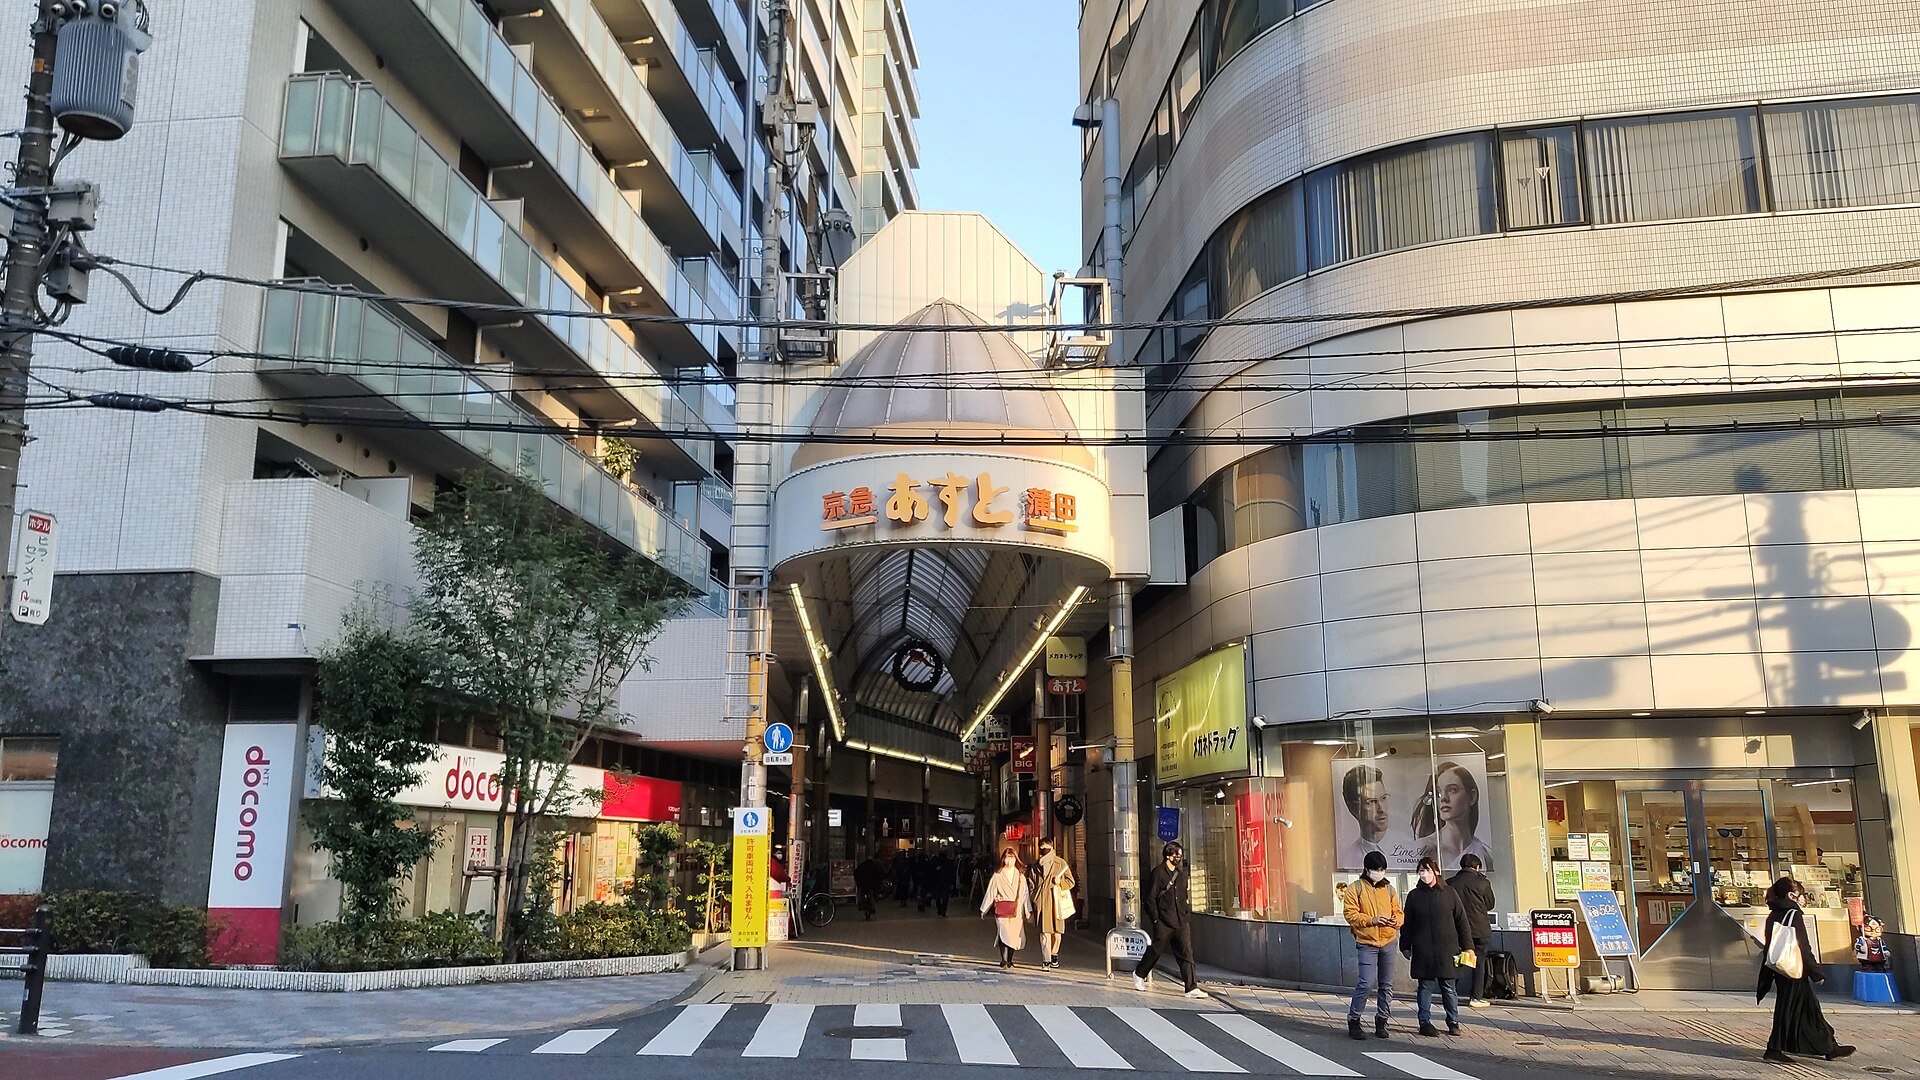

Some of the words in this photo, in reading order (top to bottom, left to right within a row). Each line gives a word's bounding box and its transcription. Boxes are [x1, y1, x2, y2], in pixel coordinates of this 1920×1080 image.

[821, 486, 878, 521] 京急
[885, 471, 1015, 529] あすと
[1026, 486, 1077, 522] 蒲田
[28, 518, 51, 532] ホテル
[1052, 679, 1082, 692] あすと
[989, 741, 1008, 751] あすと
[1193, 725, 1240, 760] メガネドラッグ
[463, 756, 476, 768] NTT
[1014, 760, 1033, 768] BIG
[445, 755, 519, 802] doco
[234, 745, 271, 882] docomo
[1113, 936, 1144, 945] 許可車両以外
[1535, 931, 1575, 945] 補聴器
[1114, 944, 1144, 953] 入れません!
